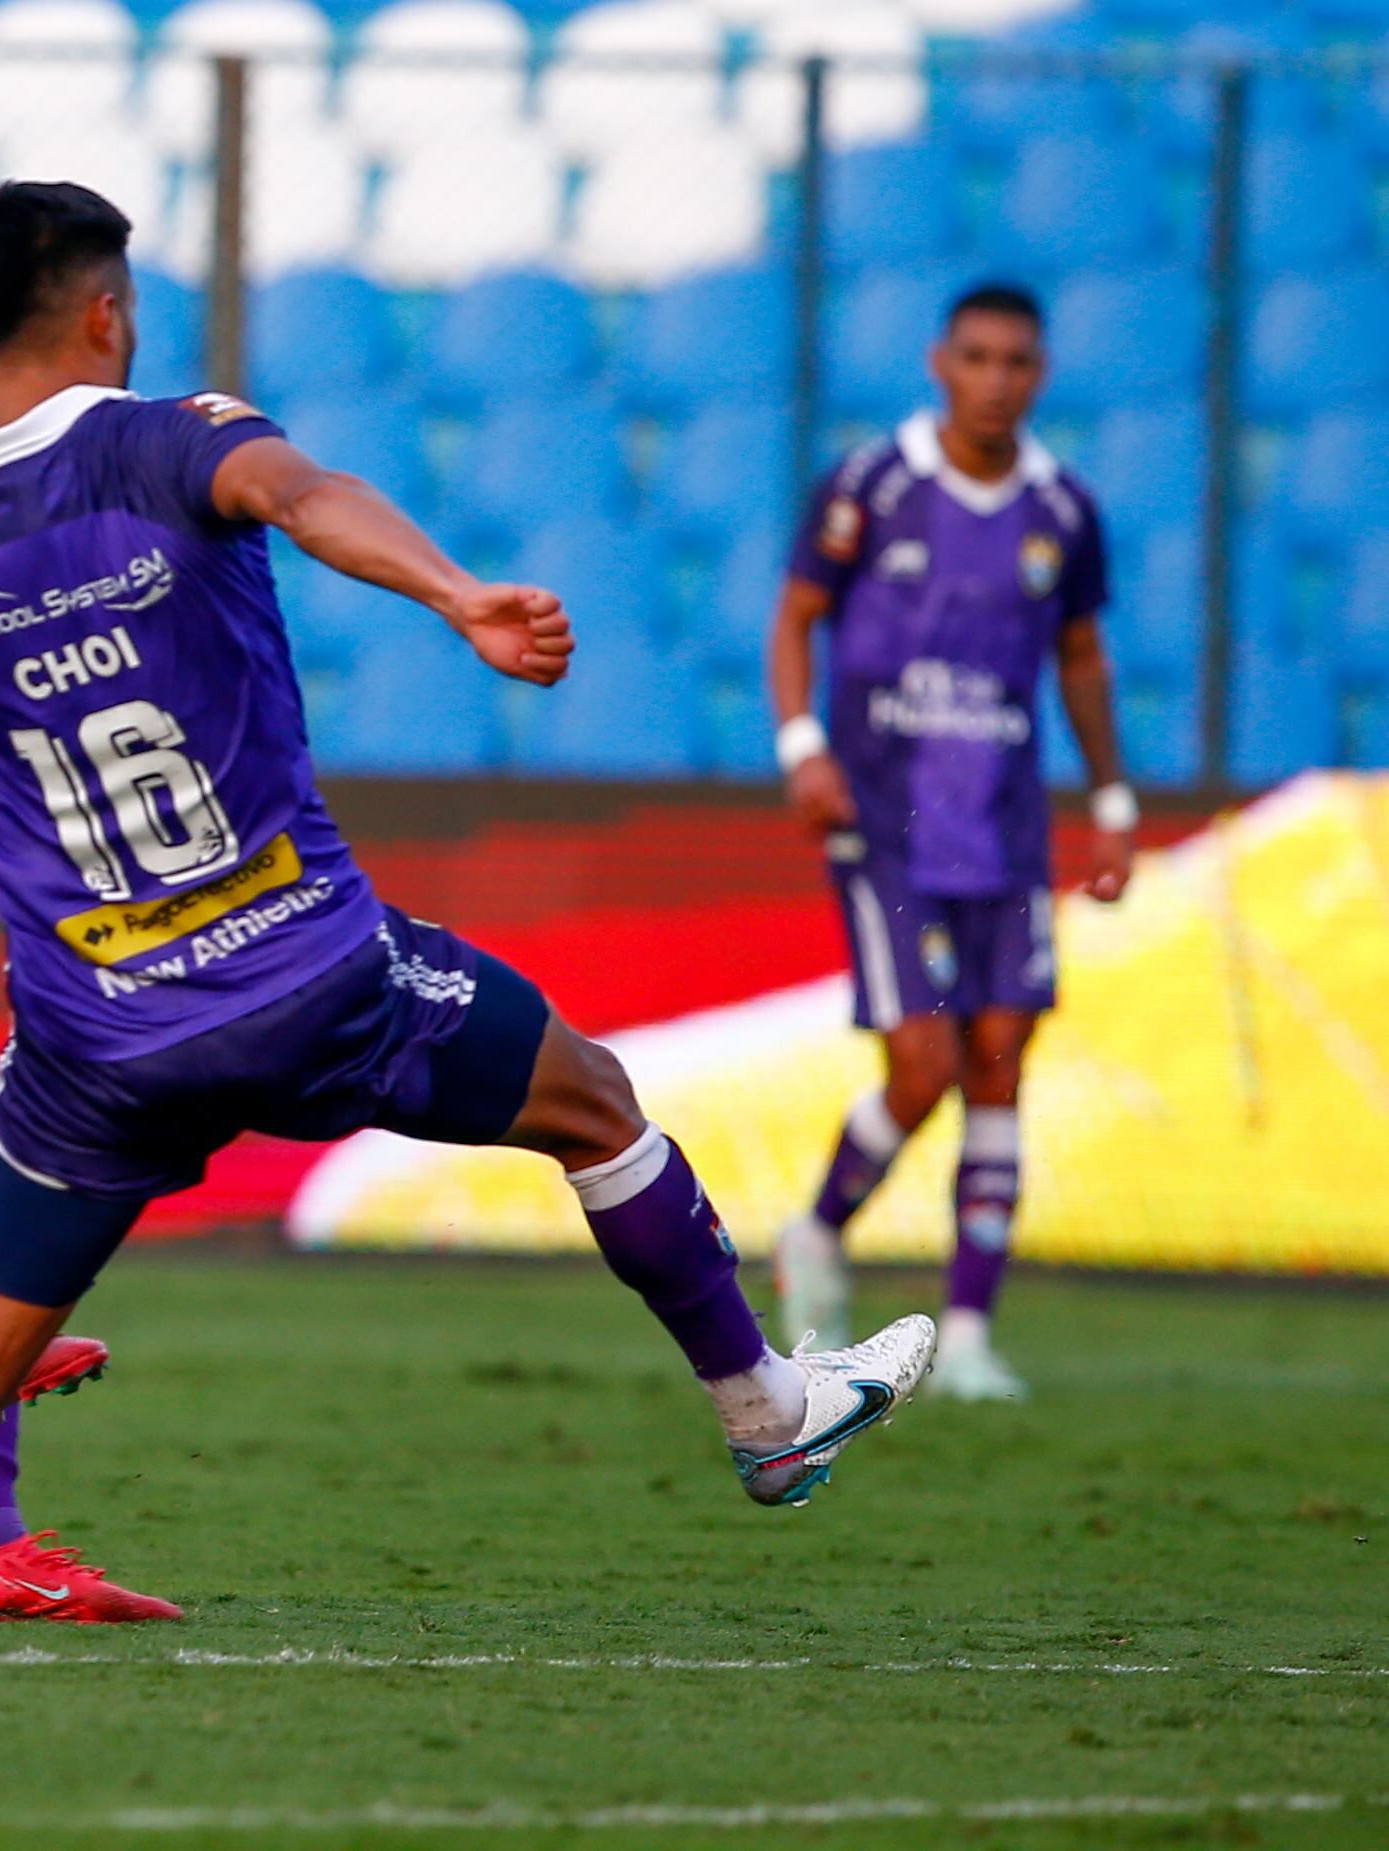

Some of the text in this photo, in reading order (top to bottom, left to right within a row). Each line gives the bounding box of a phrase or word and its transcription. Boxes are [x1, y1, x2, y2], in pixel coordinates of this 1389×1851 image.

[14, 626, 142, 701] CHOI
[8, 699, 240, 901] 16
[190, 876, 335, 969] Athletic
